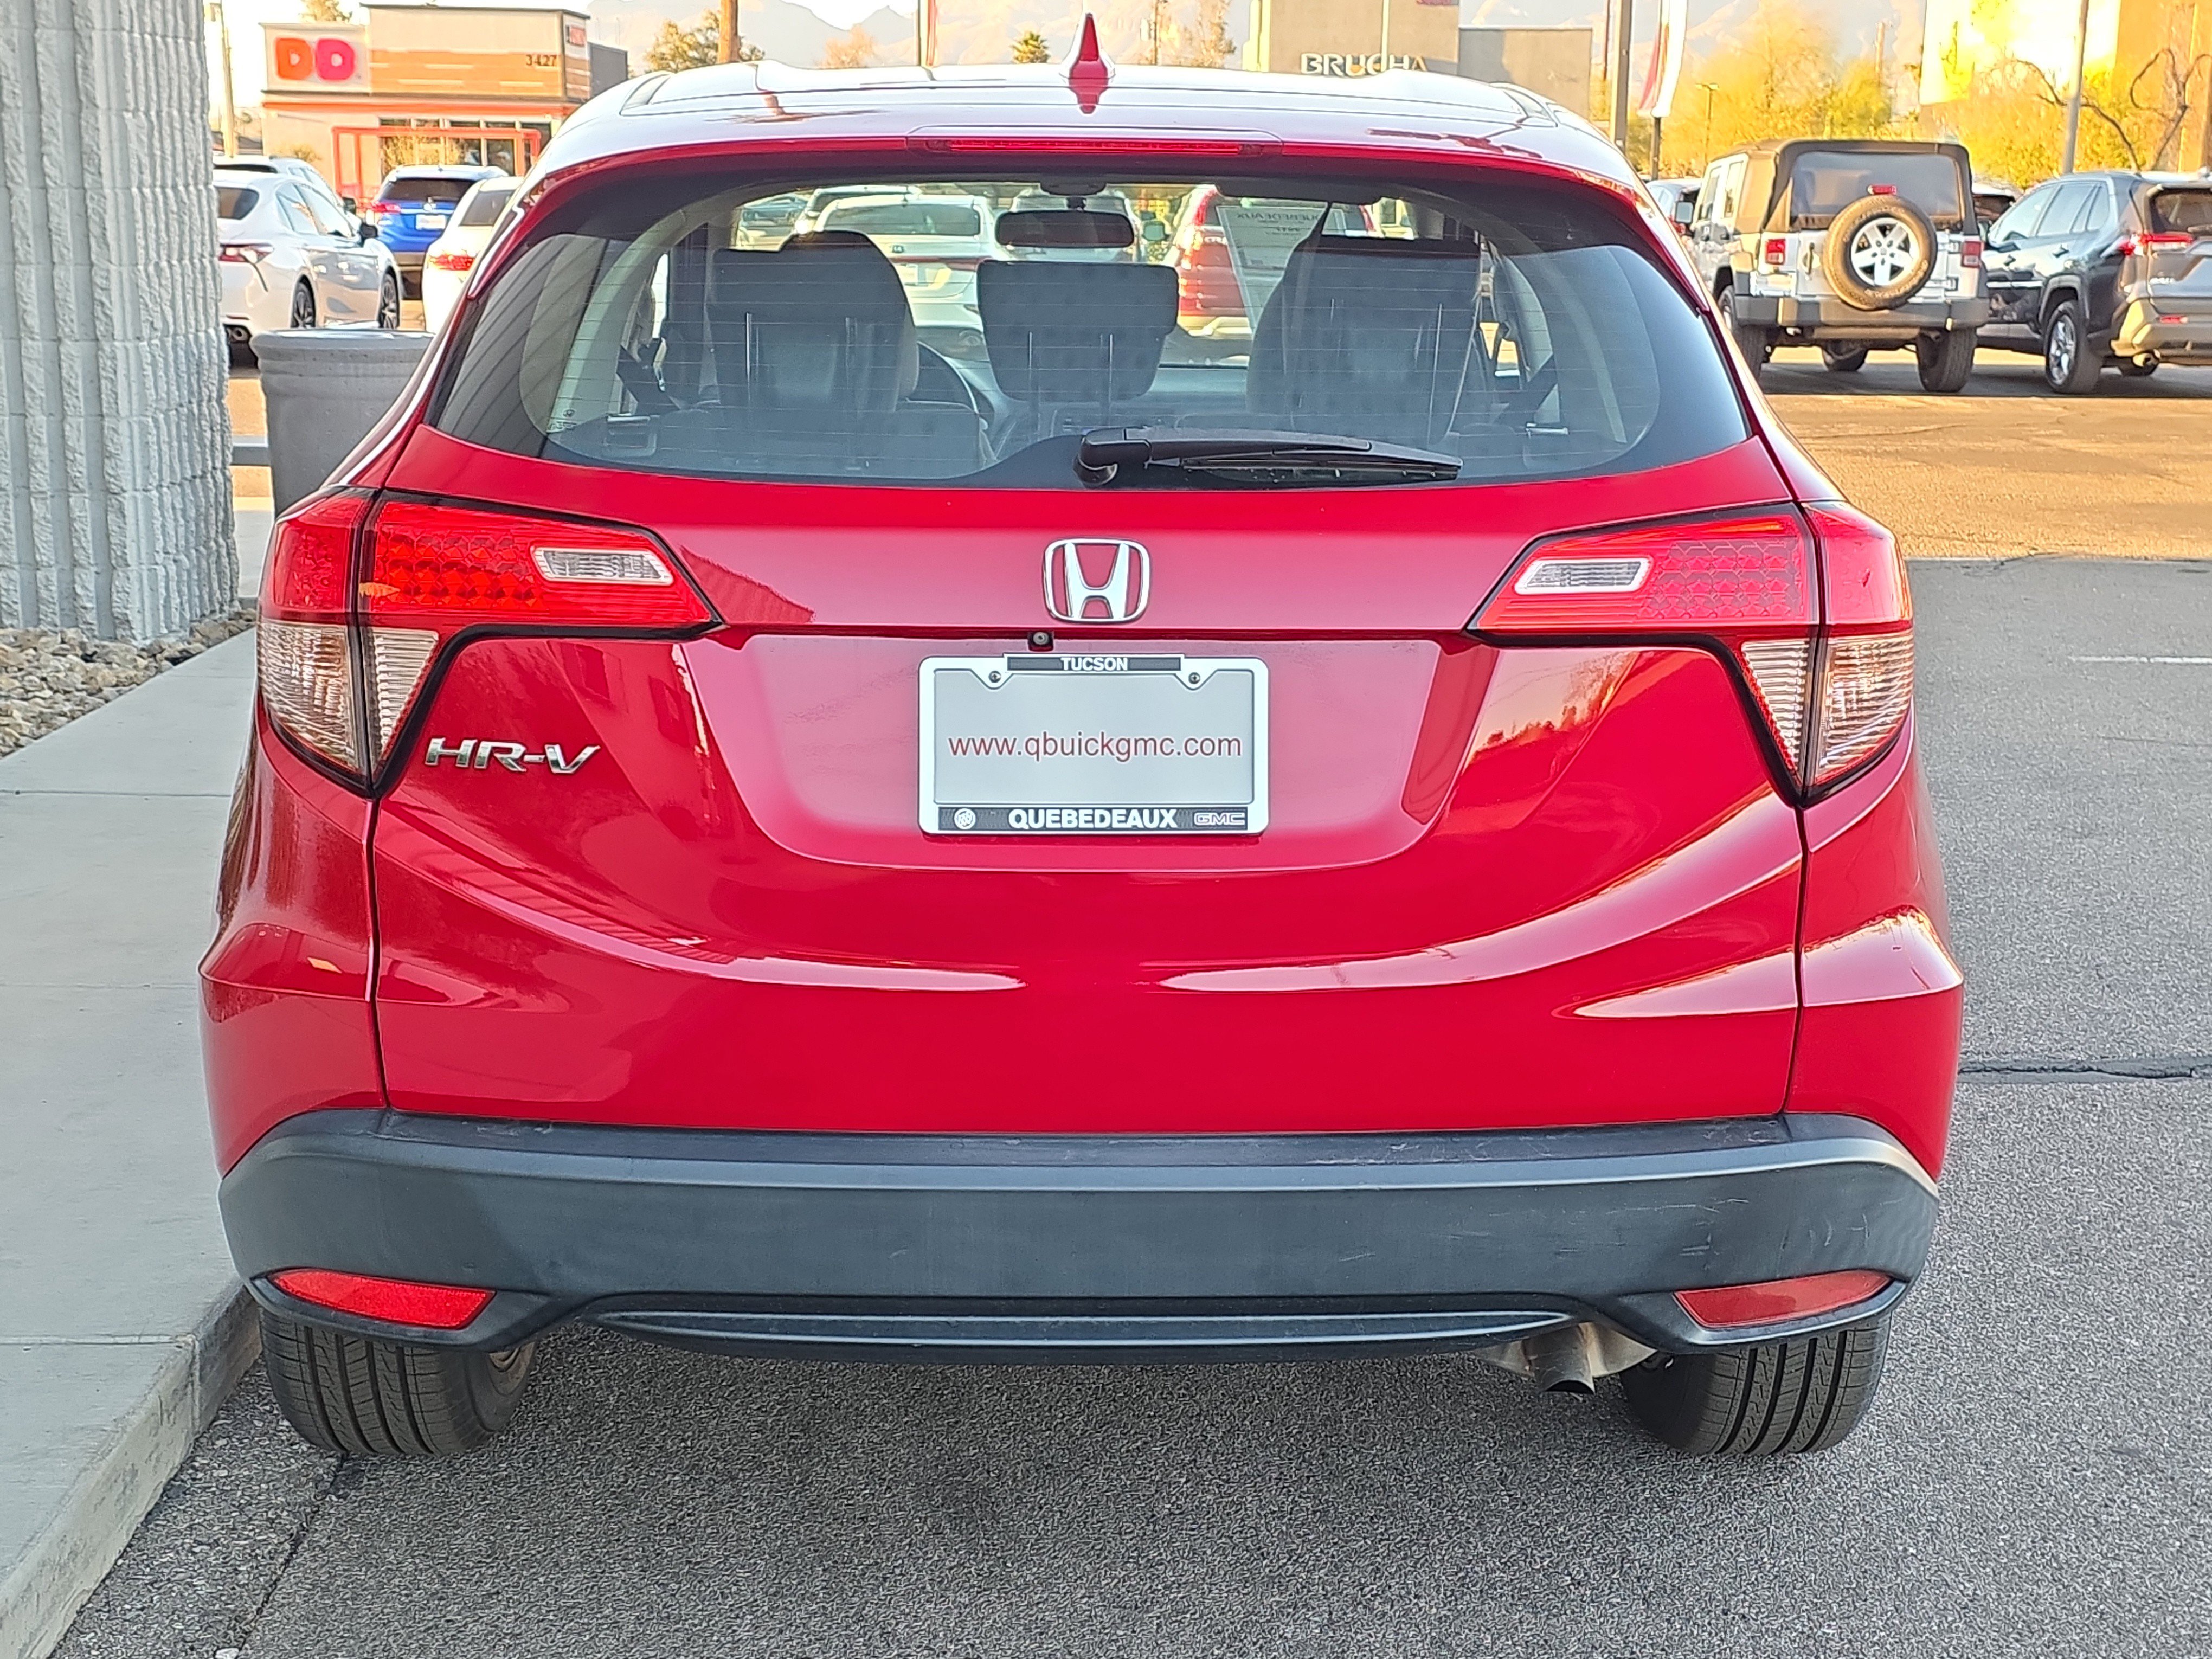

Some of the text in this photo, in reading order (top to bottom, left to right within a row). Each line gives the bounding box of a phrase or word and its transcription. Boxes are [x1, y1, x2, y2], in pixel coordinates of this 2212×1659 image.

[526, 54, 557, 67] 3427
[1060, 657, 1128, 671] TUCSON
[425, 737, 600, 774] HR-V
[948, 732, 1242, 763] www.qbuickgmc.com
[1008, 809, 1178, 829] QUEBEDEAUX
[1193, 812, 1245, 826] GMC
